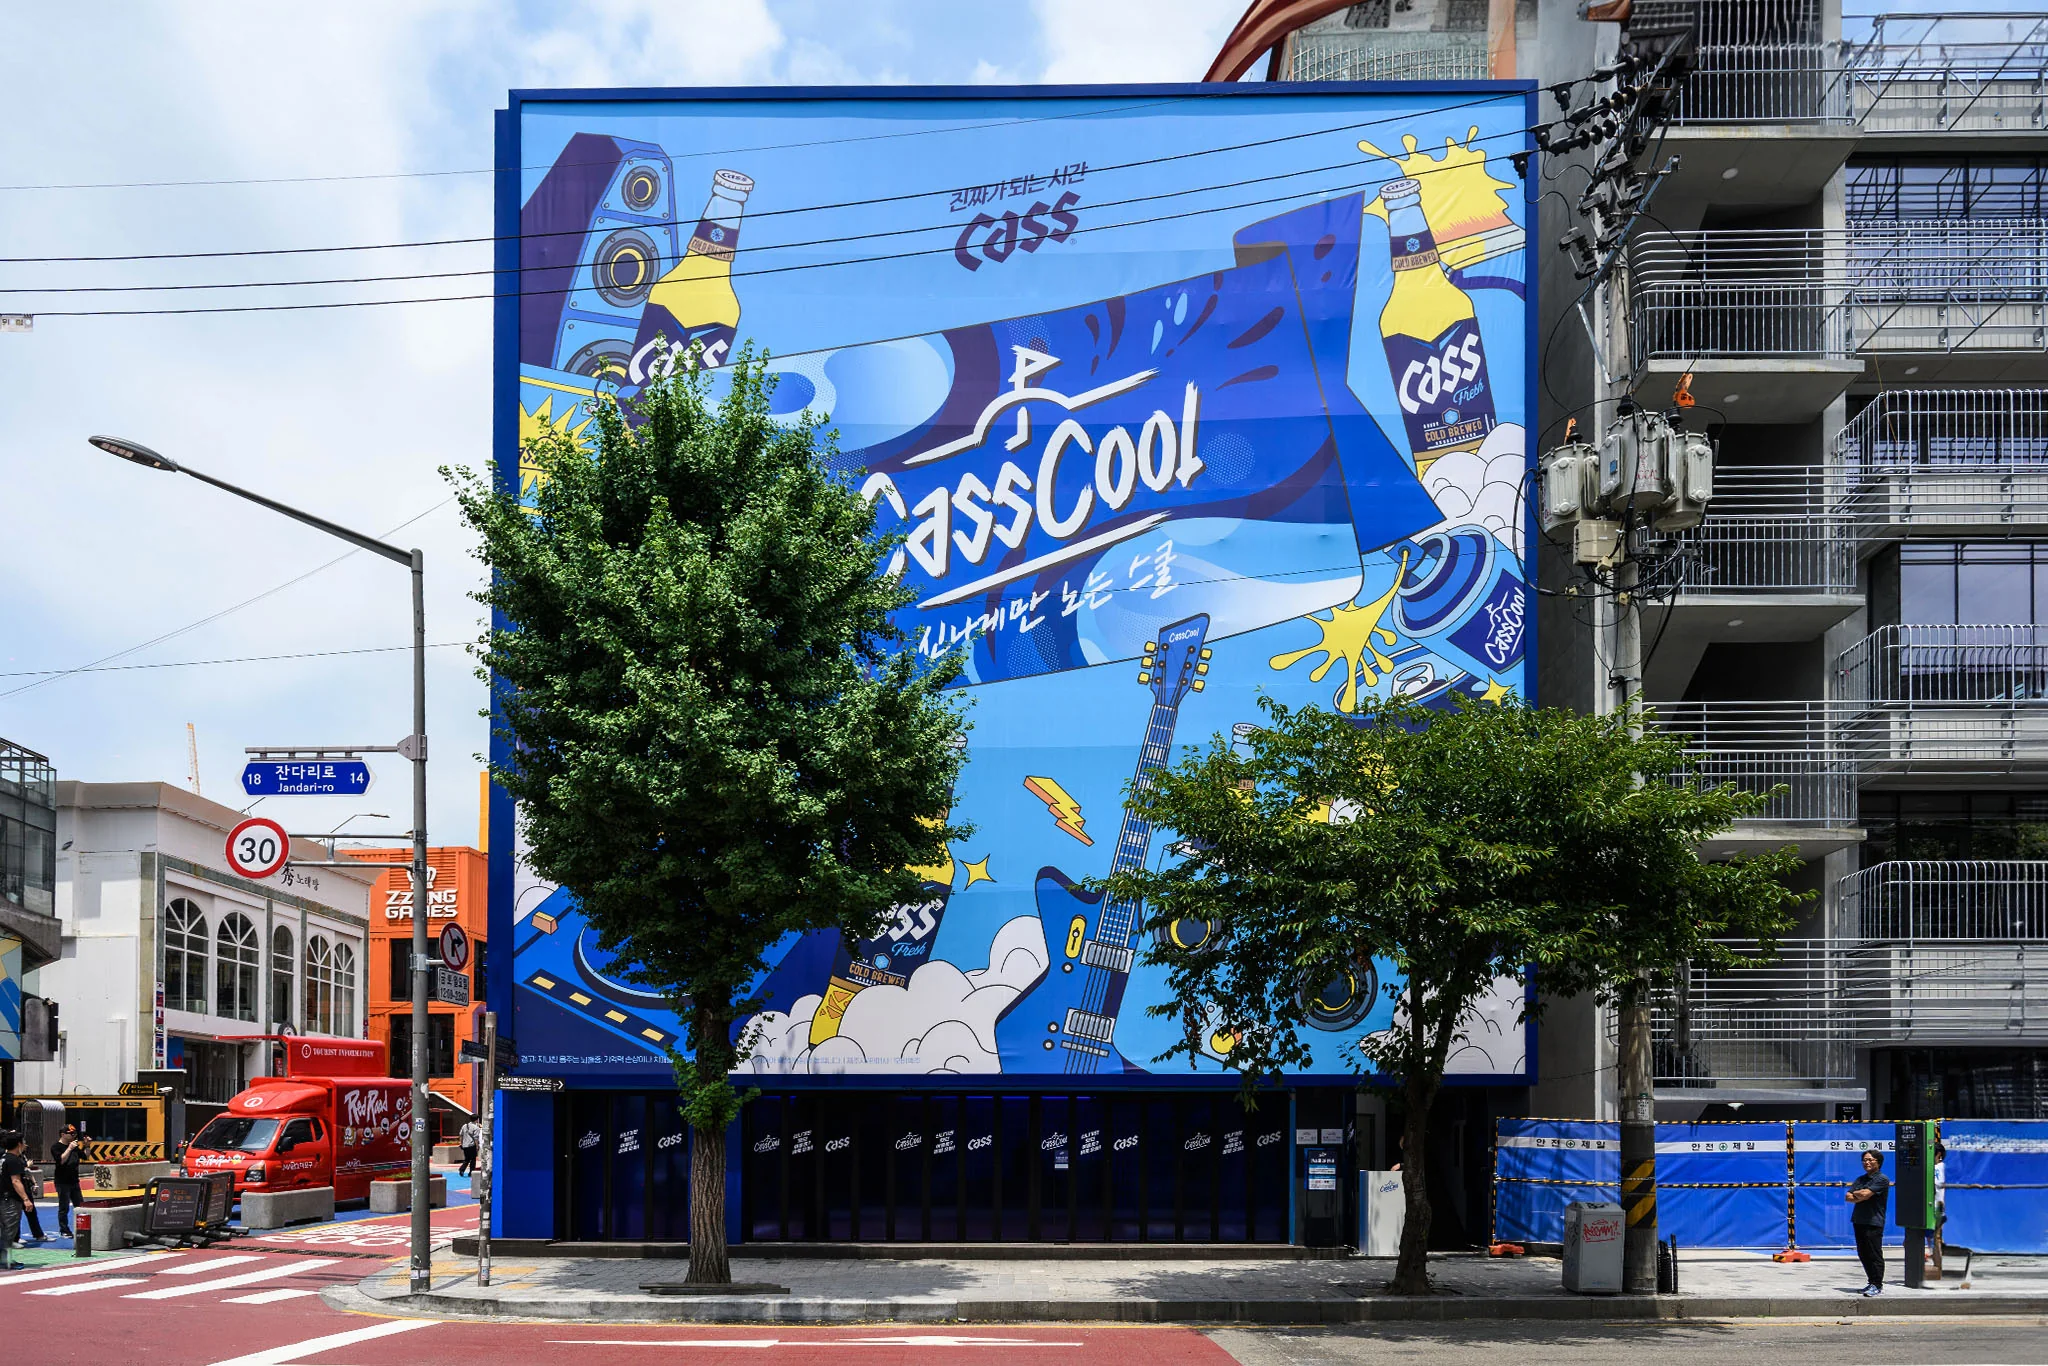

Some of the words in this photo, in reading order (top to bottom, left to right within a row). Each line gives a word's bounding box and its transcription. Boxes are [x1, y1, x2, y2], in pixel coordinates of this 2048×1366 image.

[721, 171, 748, 182] Cass
[1048, 161, 1089, 188] 시간
[954, 190, 1082, 272] Cass
[1394, 256, 1411, 269] COLD
[1411, 251, 1437, 266] BREWED
[1399, 333, 1482, 415] Cass
[1453, 378, 1485, 406] Fresh
[1424, 427, 1448, 443] COLD
[1448, 421, 1484, 438] BREWED
[918, 590, 1050, 660] 신나게만
[1061, 571, 1115, 618] 노는
[1128, 540, 1180, 600] 스쿨
[1168, 627, 1200, 643] CassCool
[247, 774, 262, 785] 18
[275, 764, 337, 781] 잔다리로
[350, 772, 365, 784] 14
[277, 782, 335, 793] Jandari-ro
[238, 837, 276, 865] 30
[385, 888, 459, 905] ZZNG
[384, 904, 459, 920] GAES
[891, 941, 927, 957] Fresh
[849, 963, 869, 978] COLD
[871, 970, 906, 987] BREWED
[313, 1048, 337, 1056] TOURIST
[338, 1049, 375, 1057] INFORMATION
[657, 1133, 683, 1149] Cass
[825, 1136, 850, 1152] Cass
[967, 1135, 993, 1151] Cass
[1113, 1135, 1139, 1151] Cass
[1256, 1131, 1282, 1147] Cass
[1536, 1138, 1560, 1148] 안전
[1581, 1140, 1606, 1149] 제일
[1691, 1142, 1715, 1151] 안전
[1732, 1142, 1755, 1151] 제일
[1830, 1141, 1854, 1151] 안전
